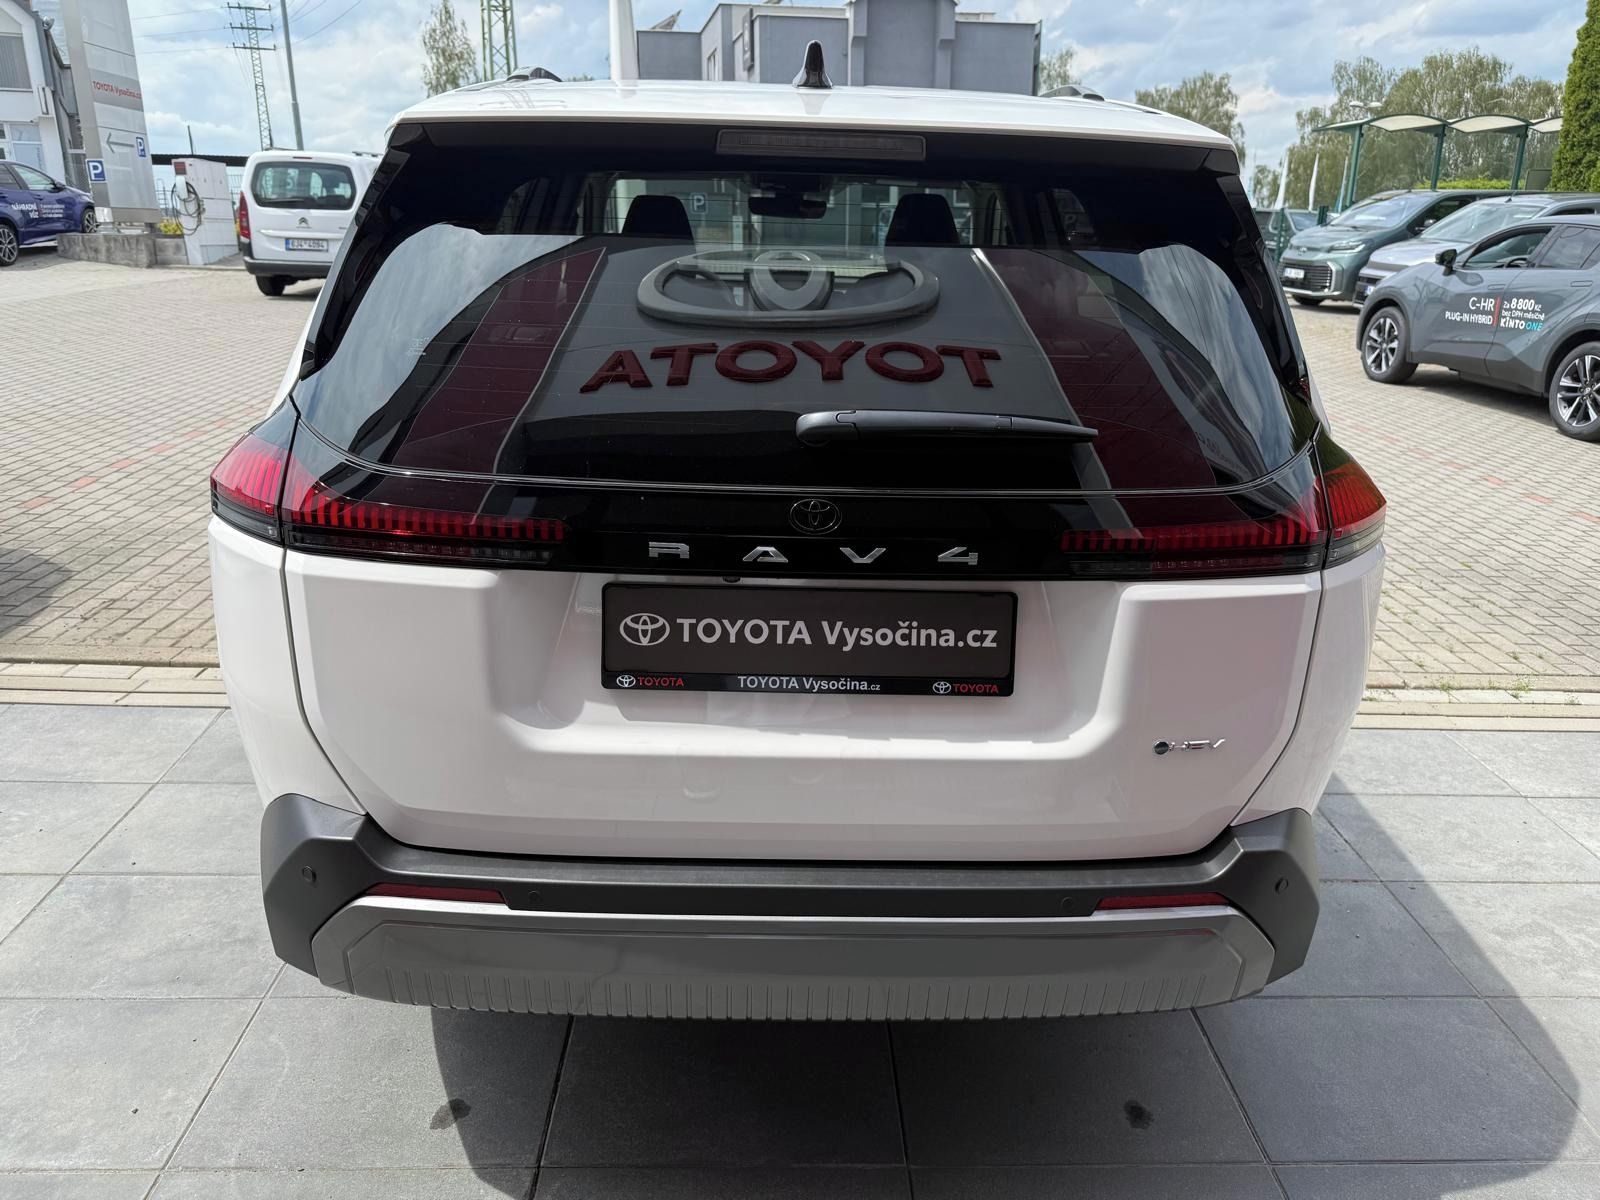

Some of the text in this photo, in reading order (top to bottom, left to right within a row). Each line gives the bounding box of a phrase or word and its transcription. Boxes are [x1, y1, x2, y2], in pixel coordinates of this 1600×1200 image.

[137, 138, 145, 157] P
[88, 162, 102, 180] P
[693, 195, 705, 211] P
[1468, 297, 1495, 311] C-HR
[1445, 311, 1493, 325] PLUG-IN HYBRID
[1512, 310, 1524, 318] DPH
[1524, 311, 1545, 321] měsíčně
[1526, 321, 1543, 331] ONE
[648, 541, 978, 566] RAV4
[676, 617, 998, 652] TOYOTA Vysočina.cz
[637, 676, 684, 688] TOYOTA
[737, 675, 881, 692] TOYOTA Vysočina.cz
[953, 683, 999, 694] TOYOTA
